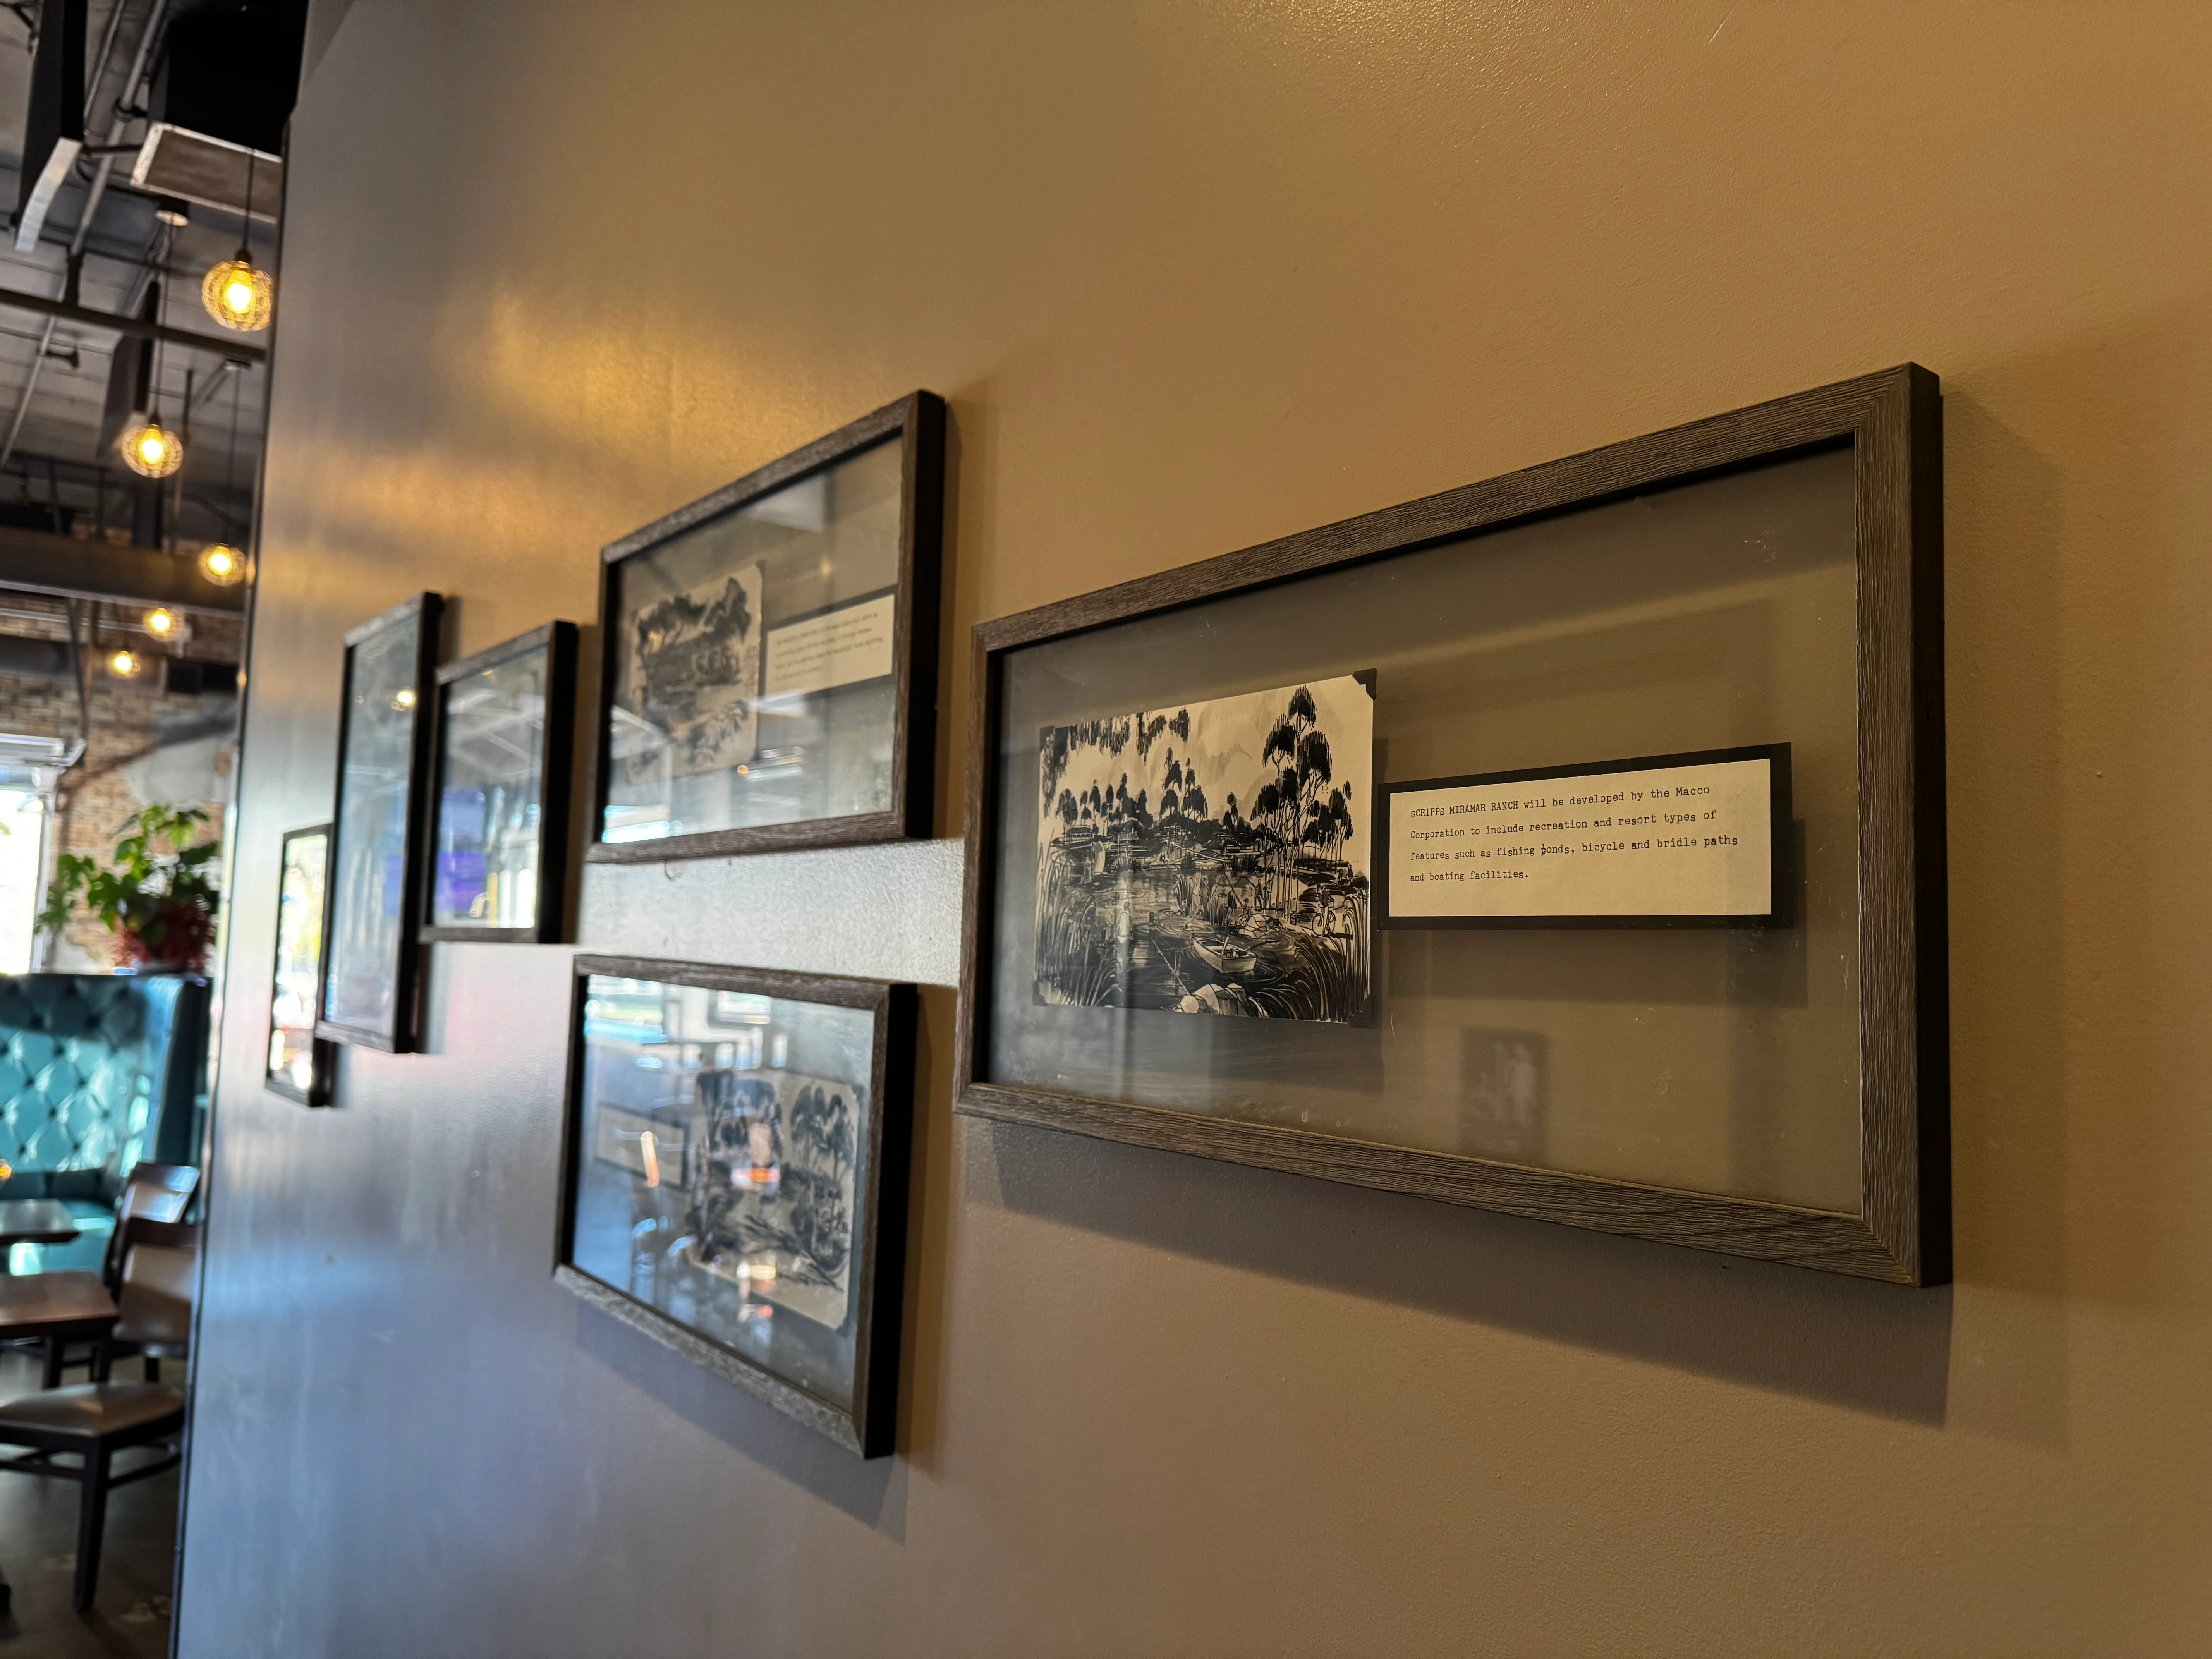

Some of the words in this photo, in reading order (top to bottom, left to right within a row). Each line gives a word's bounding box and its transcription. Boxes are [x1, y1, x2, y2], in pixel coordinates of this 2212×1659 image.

[1411, 807, 1445, 818] SCRIPPS
[1449, 803, 1486, 814] MIRAMAR
[1491, 800, 1519, 811] RANCH
[1523, 799, 1546, 809] will
[1552, 798, 1564, 806] be
[1570, 792, 1625, 805] developed
[1630, 791, 1644, 802] by
[1650, 789, 1669, 799] the
[1676, 787, 1710, 796] Macco
[1410, 828, 1465, 840] Corporation
[1470, 827, 1480, 835] to
[1486, 824, 1524, 834] include
[1529, 819, 1588, 831] recreation
[1594, 817, 1612, 827] and
[1618, 814, 1656, 826] resort
[1664, 813, 1696, 824] types
[1703, 810, 1717, 820] of
[1410, 852, 1449, 860] features
[1455, 849, 1475, 859] such
[1497, 846, 1535, 857] fishing
[1581, 841, 1625, 853] bicycle
[1631, 839, 1650, 850] and
[1656, 837, 1697, 848] bridle
[1704, 835, 1738, 848] paths
[1410, 873, 1424, 882] and
[1429, 872, 1465, 882] boating
[1470, 869, 1528, 879] facilities.
